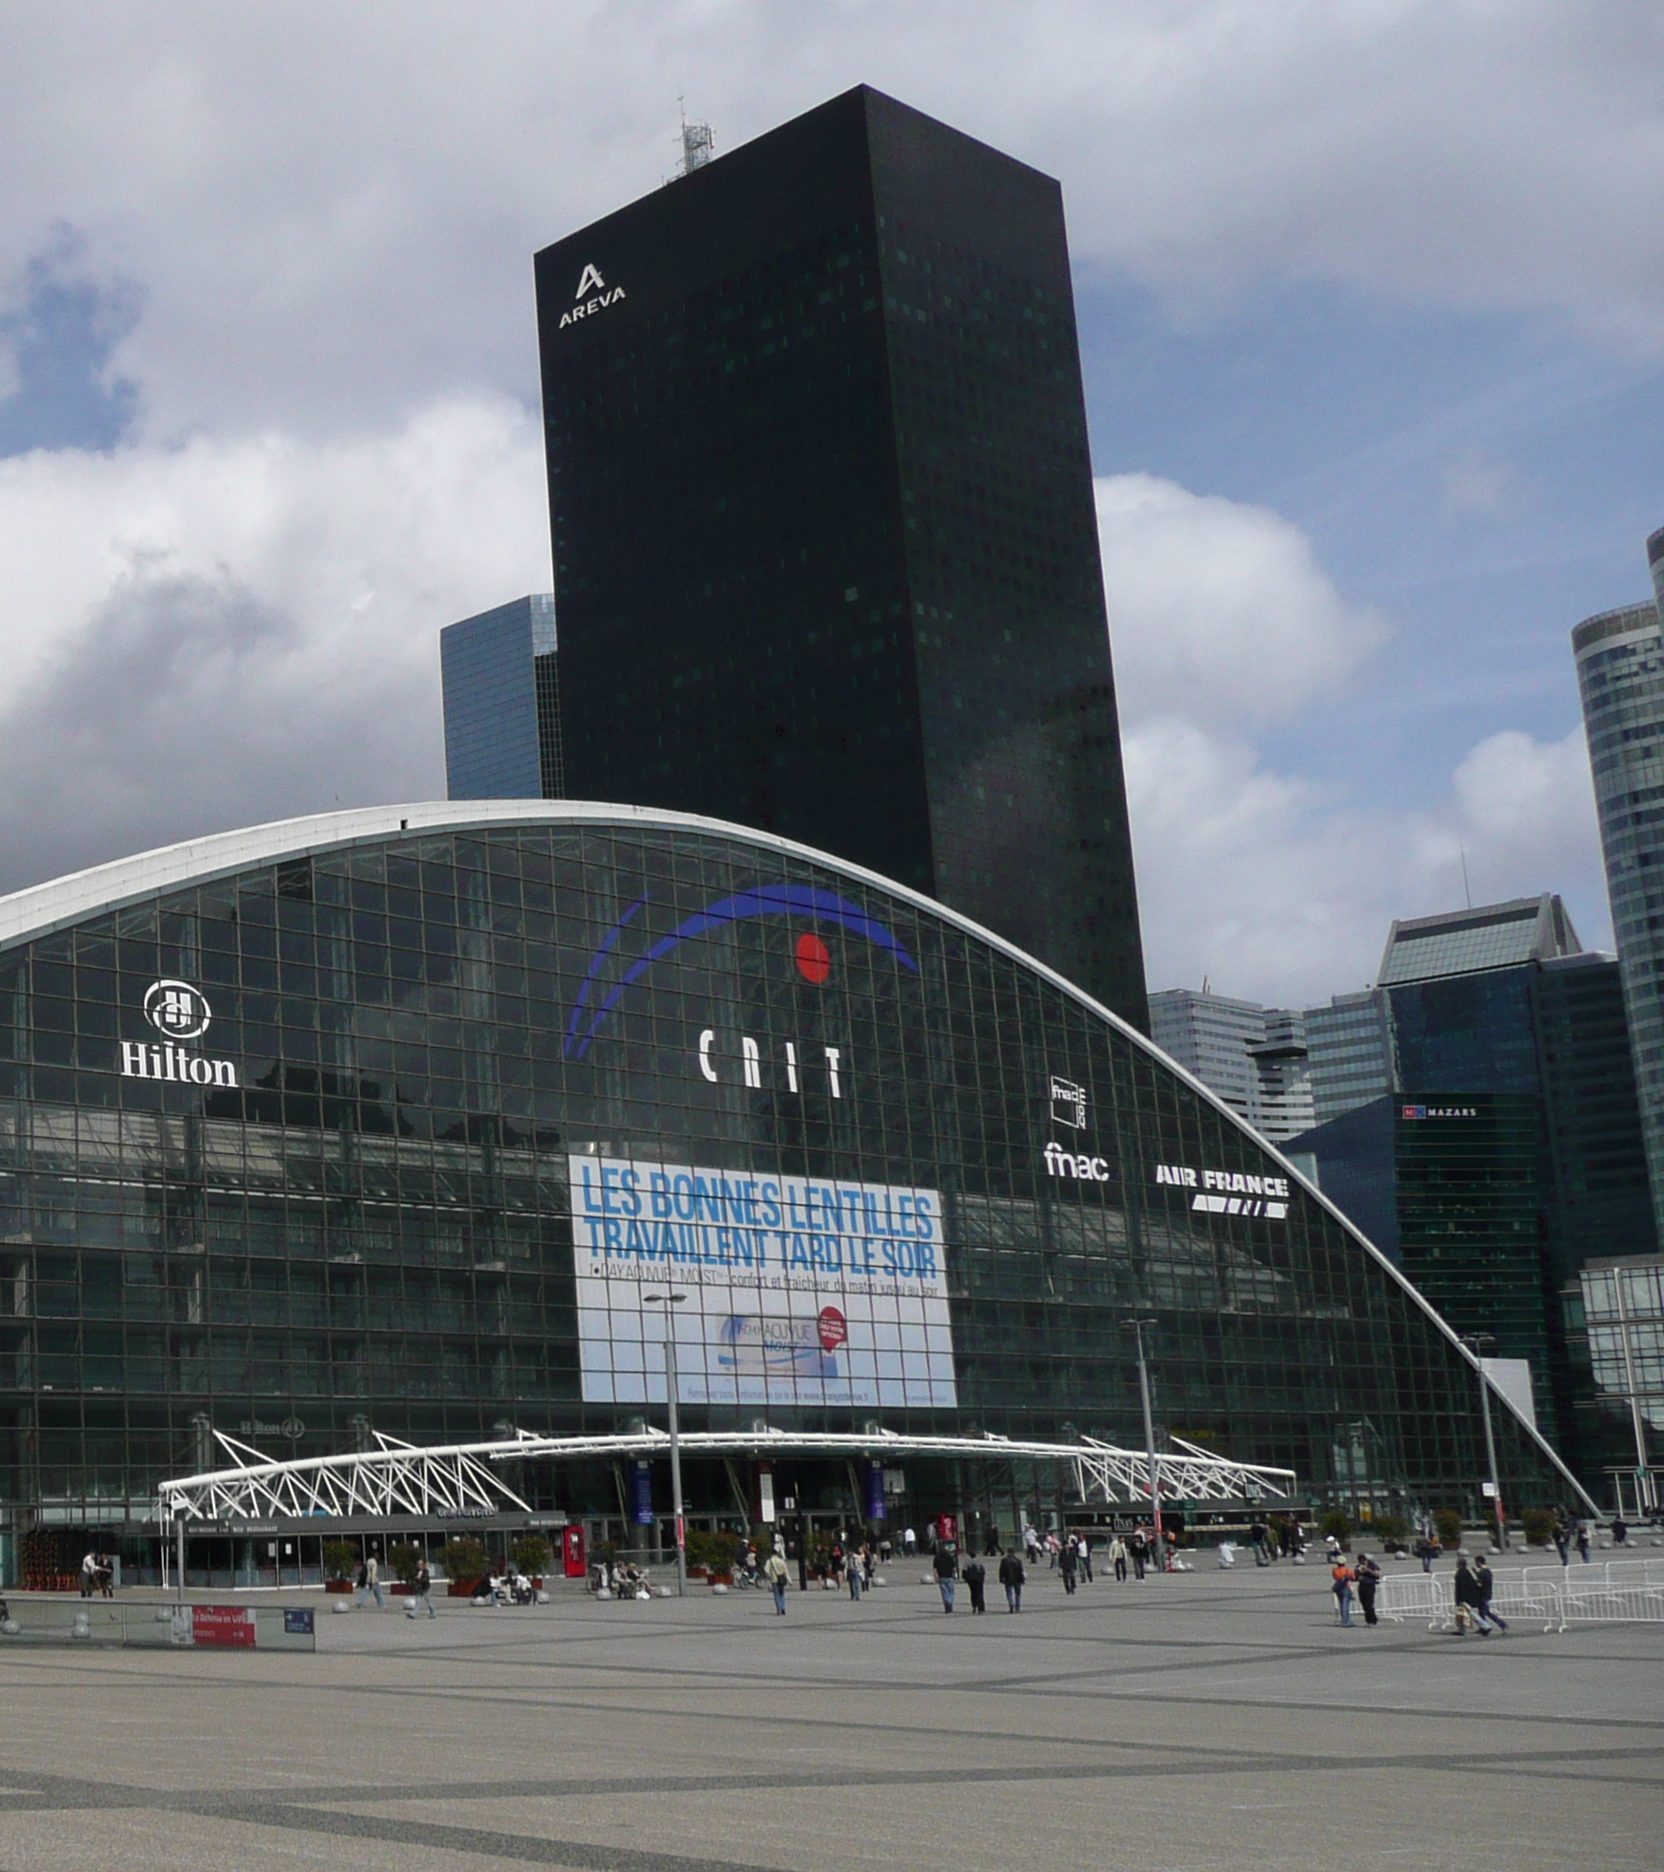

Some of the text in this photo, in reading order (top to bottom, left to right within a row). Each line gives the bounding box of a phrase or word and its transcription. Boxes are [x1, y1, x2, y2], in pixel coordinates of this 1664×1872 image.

[559, 286, 626, 329] AREVA
[120, 1040, 239, 1087] Hilton
[1052, 1085, 1078, 1101] fnac
[1427, 1108, 1477, 1116] MAZARS
[1043, 1141, 1110, 1181] fnac
[1156, 1164, 1289, 1197] AIR FRANCE
[582, 1165, 933, 1239] LES BONNES LENTILLES
[583, 1216, 936, 1279] TRAVAILLENT TARD LE SOIR
[731, 1272, 767, 1288] confort
[771, 1275, 781, 1287] et
[849, 1280, 876, 1294] matin
[879, 1280, 919, 1297] jusqu'au
[921, 1283, 939, 1297] soir
[764, 1323, 812, 1341] ACUVUE
